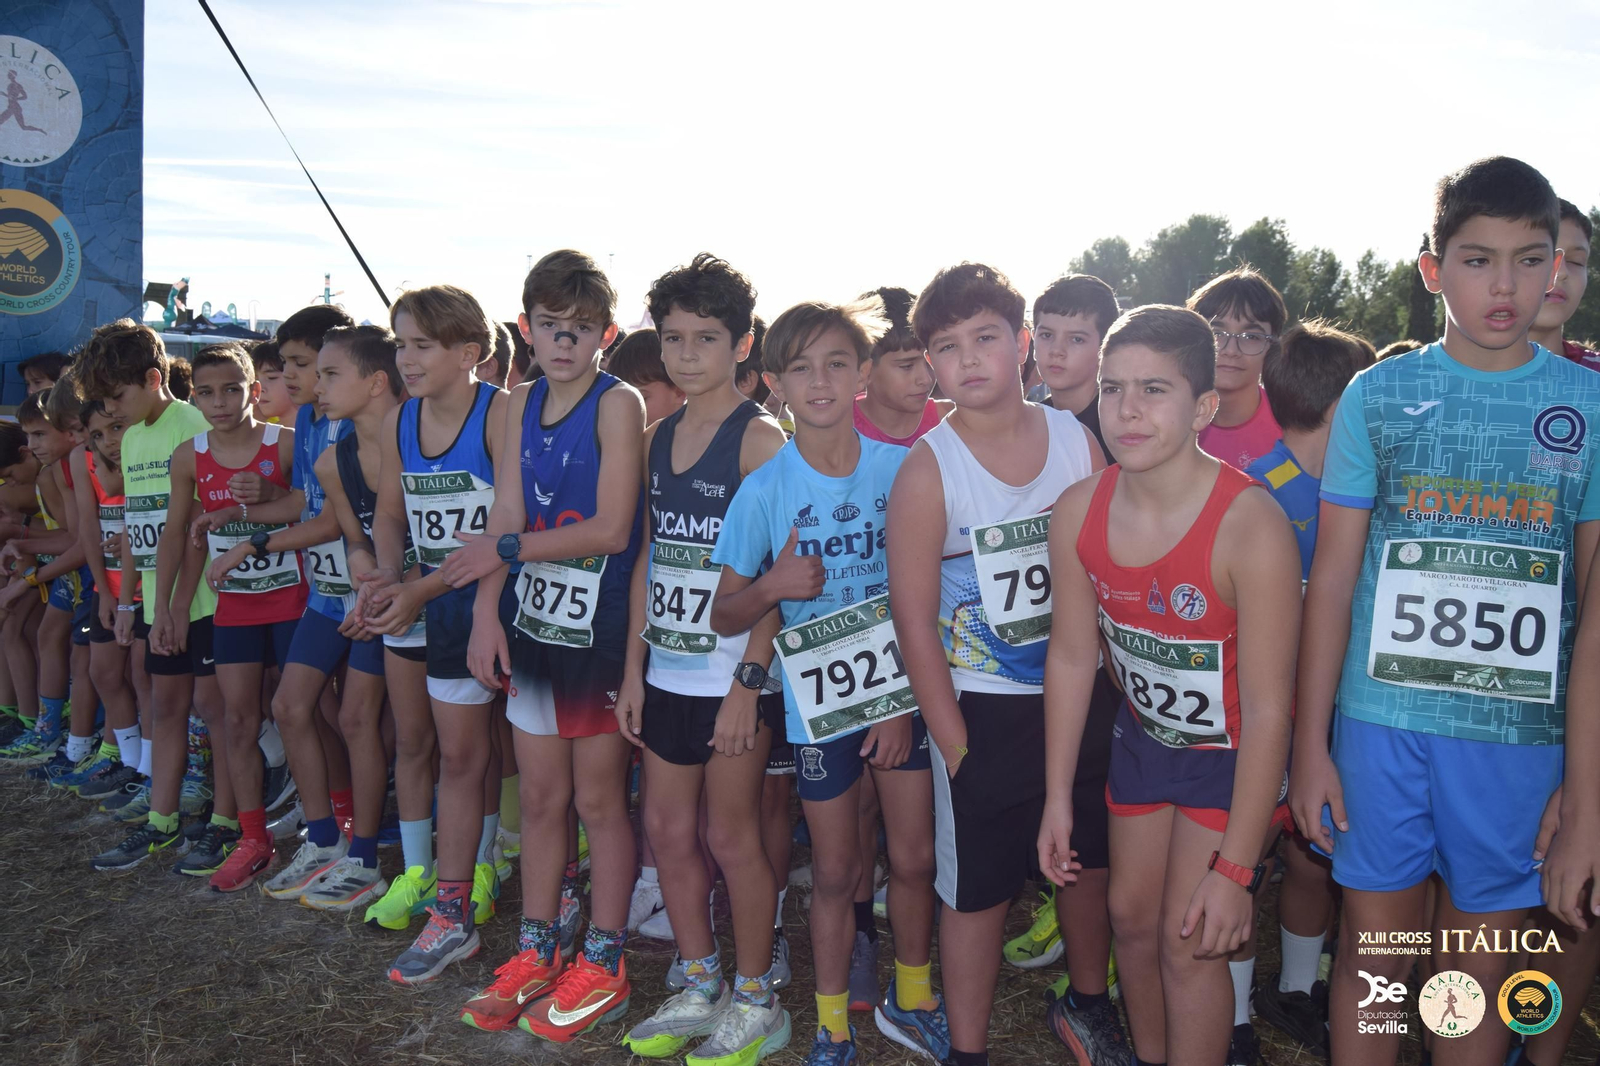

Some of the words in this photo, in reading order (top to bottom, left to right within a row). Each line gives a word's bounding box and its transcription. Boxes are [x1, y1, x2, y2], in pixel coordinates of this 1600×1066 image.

[0, 42, 71, 100] LICA
[62, 231, 76, 256] TOUR
[54, 258, 76, 296] COUNTRY
[0, 298, 24, 309] ORLD
[26, 293, 56, 309] CROSS
[418, 475, 465, 489] ITÁLICA
[1402, 475, 1483, 493] DEPORTES
[1490, 481, 1500, 494] Y
[1506, 484, 1559, 501] PESCA
[209, 490, 235, 501] GUA
[1399, 489, 1555, 526] JOVIMAR
[412, 505, 488, 541] 7874
[1013, 519, 1050, 540] ITÁL
[1405, 509, 1485, 527] Equipamos
[1489, 517, 1498, 527] a
[1503, 517, 1518, 529] tu
[1521, 519, 1551, 535] club
[655, 543, 691, 562] TÁLICA
[1434, 545, 1518, 569] ITÁLICA
[825, 561, 884, 580] TLETISMO
[1419, 571, 1448, 581] MARCO
[1449, 574, 1484, 584] MAROTO
[522, 572, 588, 621] 7875
[807, 610, 867, 640] ITÁLICA
[1391, 594, 1547, 656] 5850
[1119, 631, 1180, 661] ITÁLICA
[800, 640, 907, 706] 7921
[1114, 654, 1214, 728] 7822
